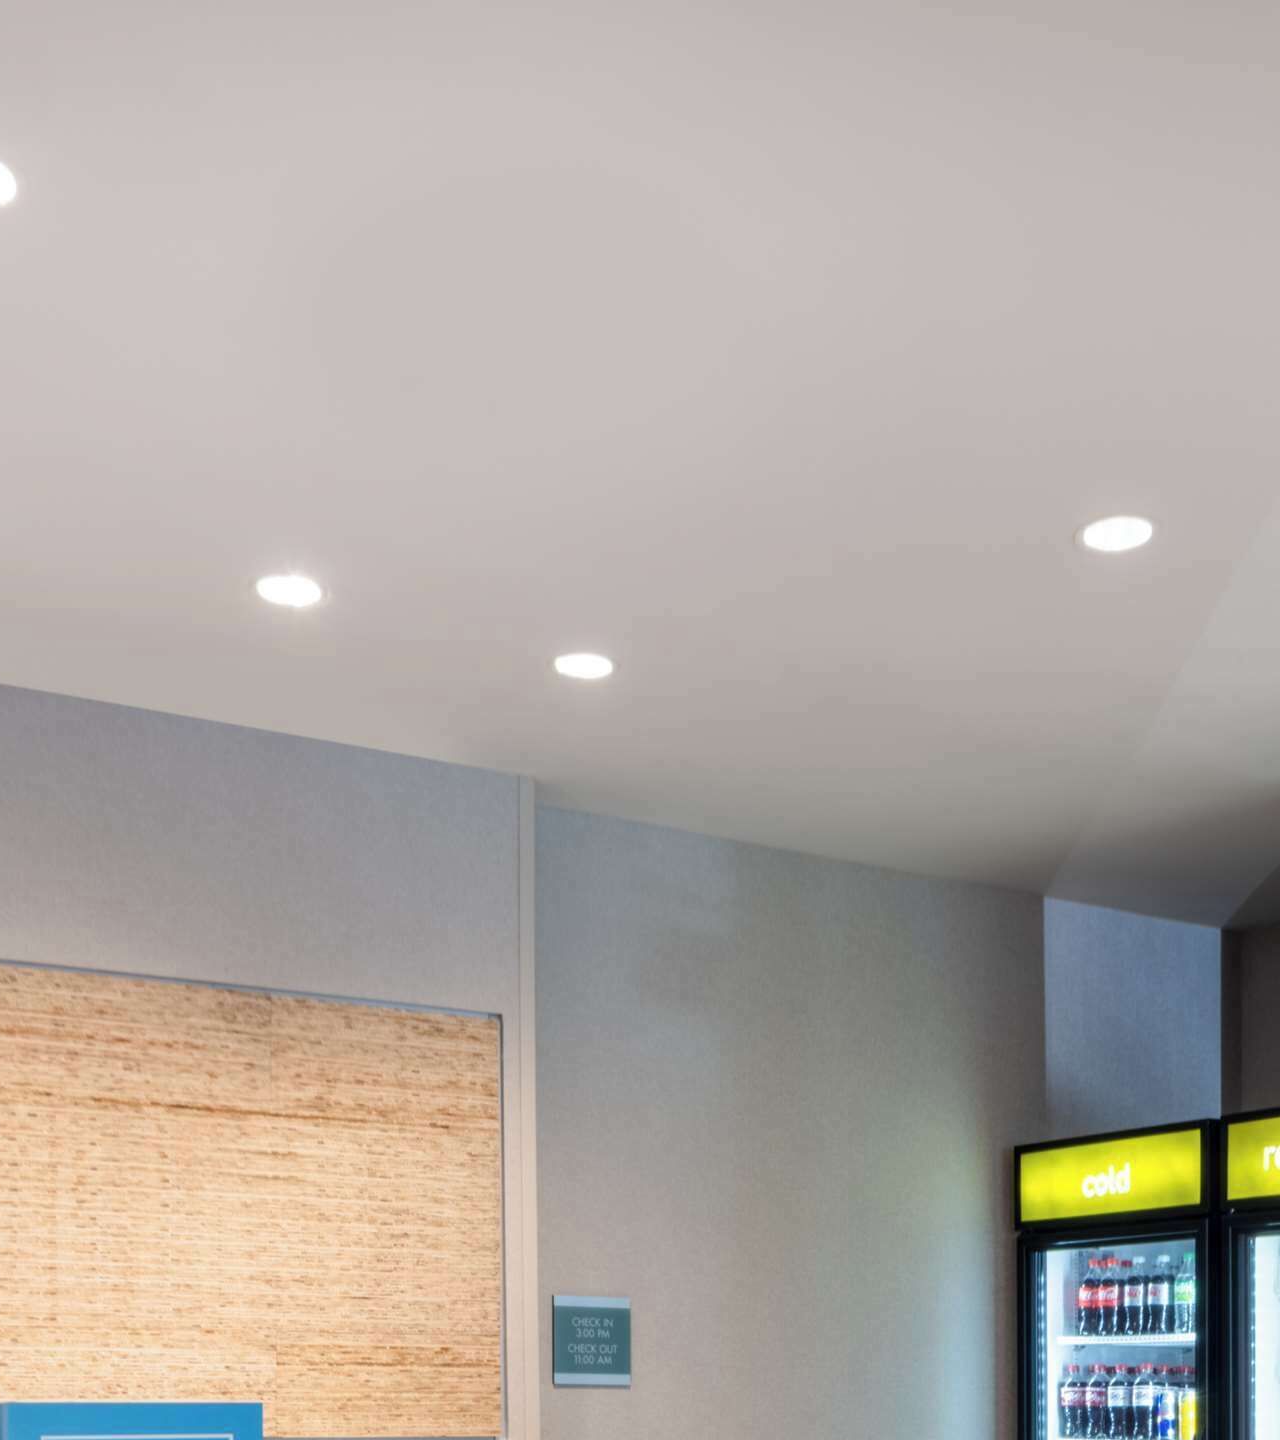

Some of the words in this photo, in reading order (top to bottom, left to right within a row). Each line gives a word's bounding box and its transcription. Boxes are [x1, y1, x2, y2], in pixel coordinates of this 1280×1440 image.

[1082, 1162, 1132, 1199] cold
[571, 1317, 600, 1328] CHECK
[603, 1318, 614, 1328] IN
[598, 1329, 610, 1339] PM
[568, 1343, 597, 1354] CHECK
[599, 1344, 617, 1355] OUT
[596, 1355, 613, 1366] AM
